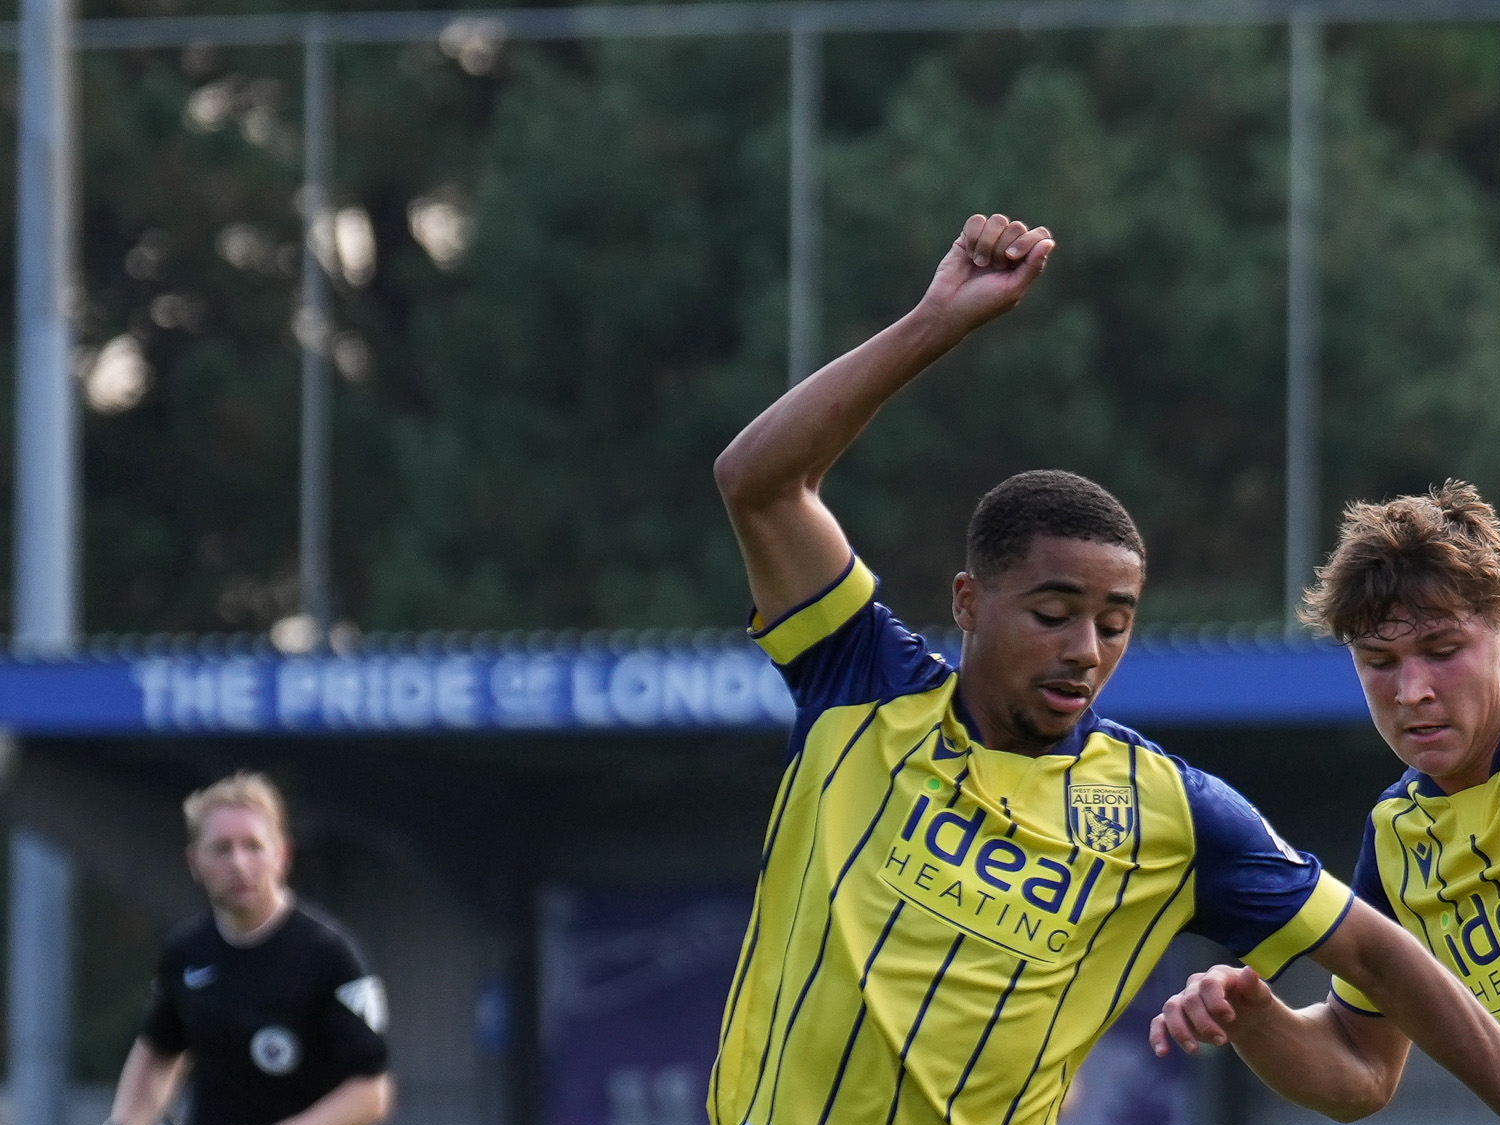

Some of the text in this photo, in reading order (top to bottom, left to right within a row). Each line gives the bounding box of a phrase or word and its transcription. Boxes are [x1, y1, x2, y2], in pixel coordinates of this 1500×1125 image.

[140, 656, 258, 729] THE
[276, 656, 478, 729] PRIDE
[570, 656, 798, 729] LONDO
[1072, 794, 1129, 805] ALBION
[901, 778, 1105, 926] ideal
[884, 846, 1070, 953] HEATING
